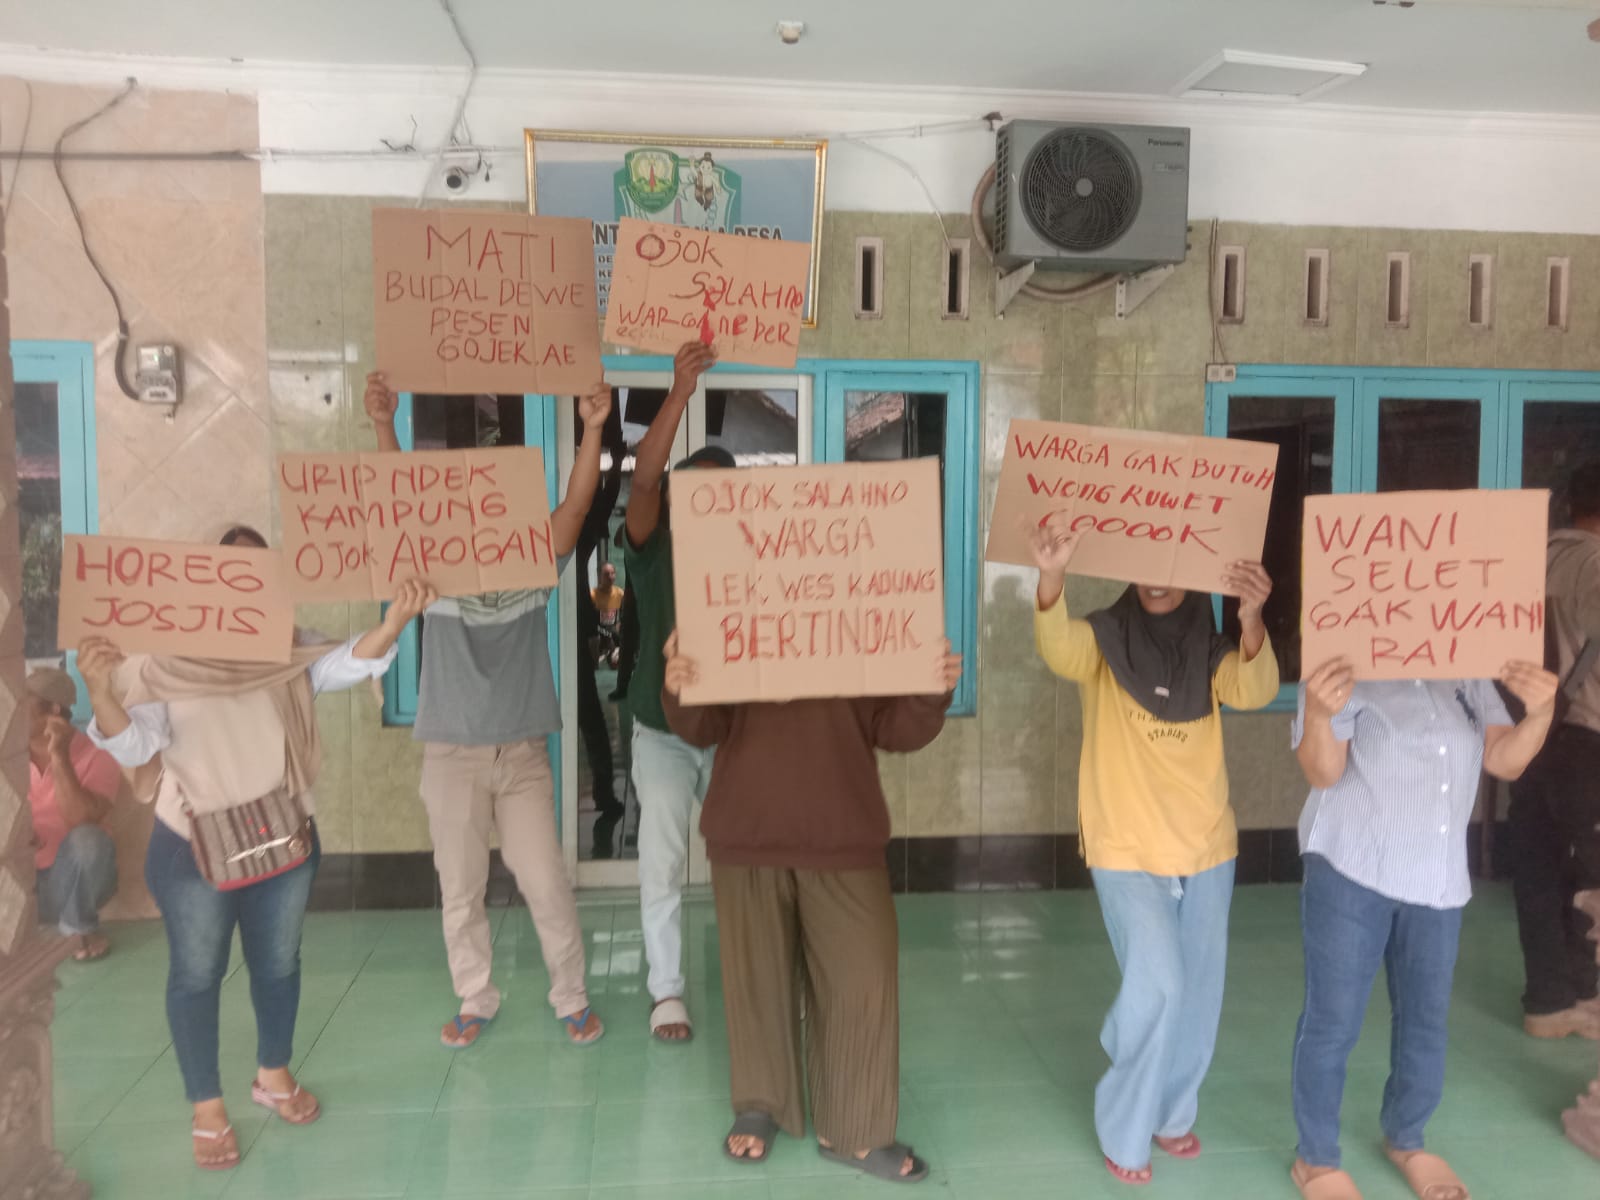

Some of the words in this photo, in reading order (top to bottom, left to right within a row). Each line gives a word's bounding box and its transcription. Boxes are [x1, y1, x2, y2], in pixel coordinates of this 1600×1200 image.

[427, 224, 555, 279] MATI
[385, 271, 489, 304] BUDAL
[499, 278, 585, 307] DEWE
[430, 307, 530, 336] PESEN
[543, 344, 577, 366] AE
[1014, 433, 1109, 468] WARGA
[1122, 450, 1182, 478] GAK
[281, 461, 376, 500] URIP
[392, 462, 497, 495] NDEK
[691, 479, 782, 517] OJOK
[792, 479, 909, 510] SALAHNO
[1120, 484, 1233, 515] RUWET
[297, 492, 507, 535] KAMPUNG
[296, 542, 379, 581] OJOK
[388, 519, 553, 583] AROGAN
[738, 515, 875, 560] WARGA
[1315, 511, 1458, 556] WANI
[76, 542, 264, 592] HOREG
[778, 571, 835, 601] WES
[848, 566, 937, 598] KADUNG
[1331, 554, 1504, 594] SELET
[720, 607, 922, 664] BERTINDAK
[1310, 598, 1414, 632] GAK
[1431, 599, 1544, 634] WANI
[1371, 636, 1458, 668] RAI
